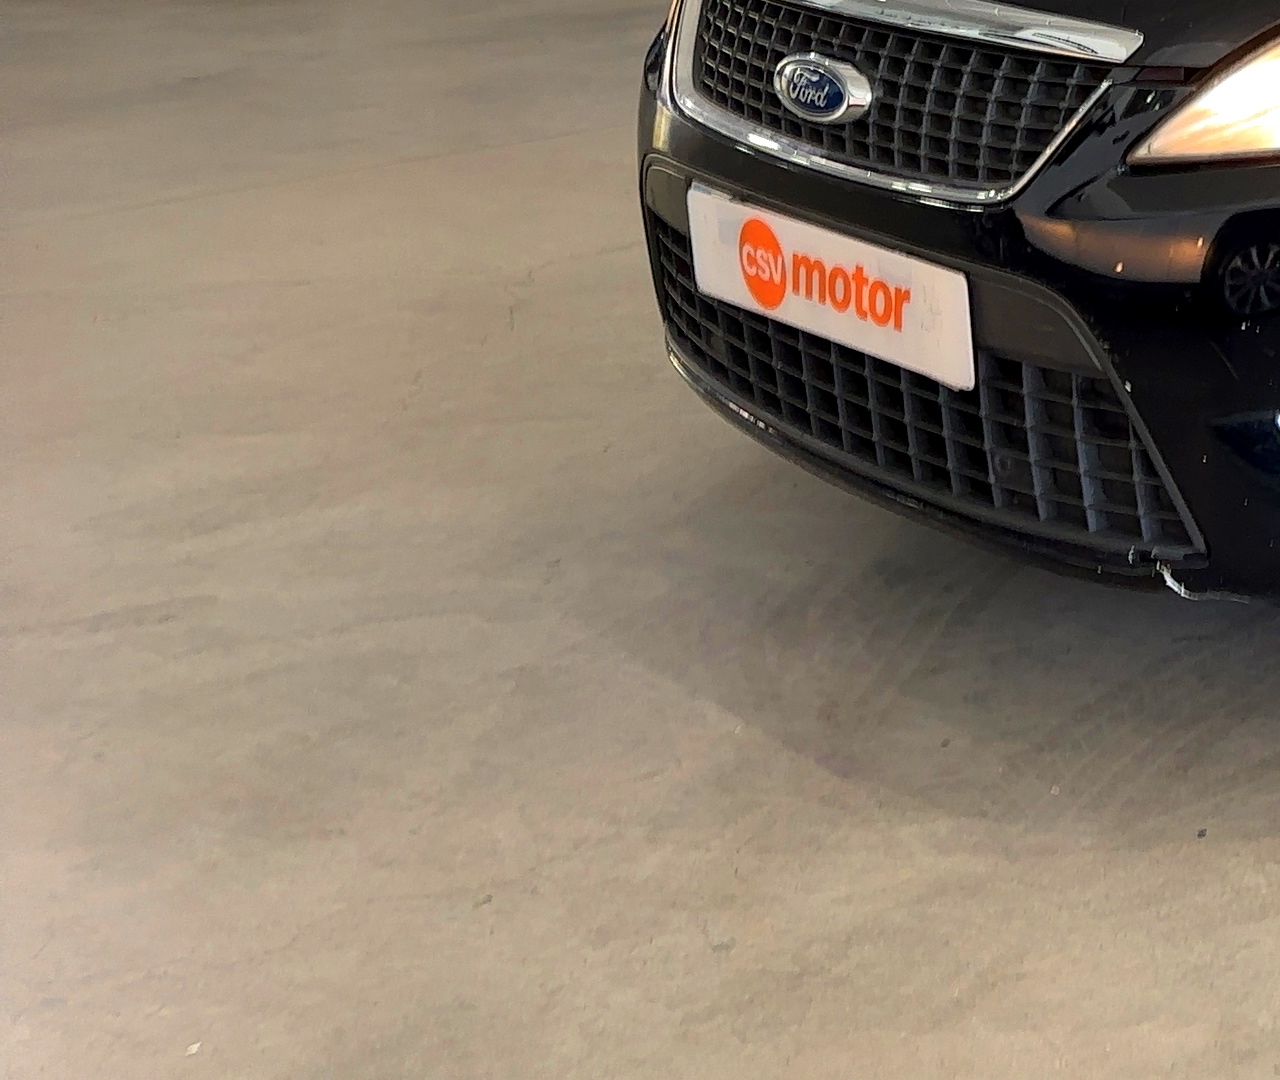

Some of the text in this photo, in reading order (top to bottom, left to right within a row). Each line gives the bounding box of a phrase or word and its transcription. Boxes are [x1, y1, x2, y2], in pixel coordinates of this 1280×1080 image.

[789, 67, 829, 108] Ford
[741, 244, 911, 332] CSV motor
